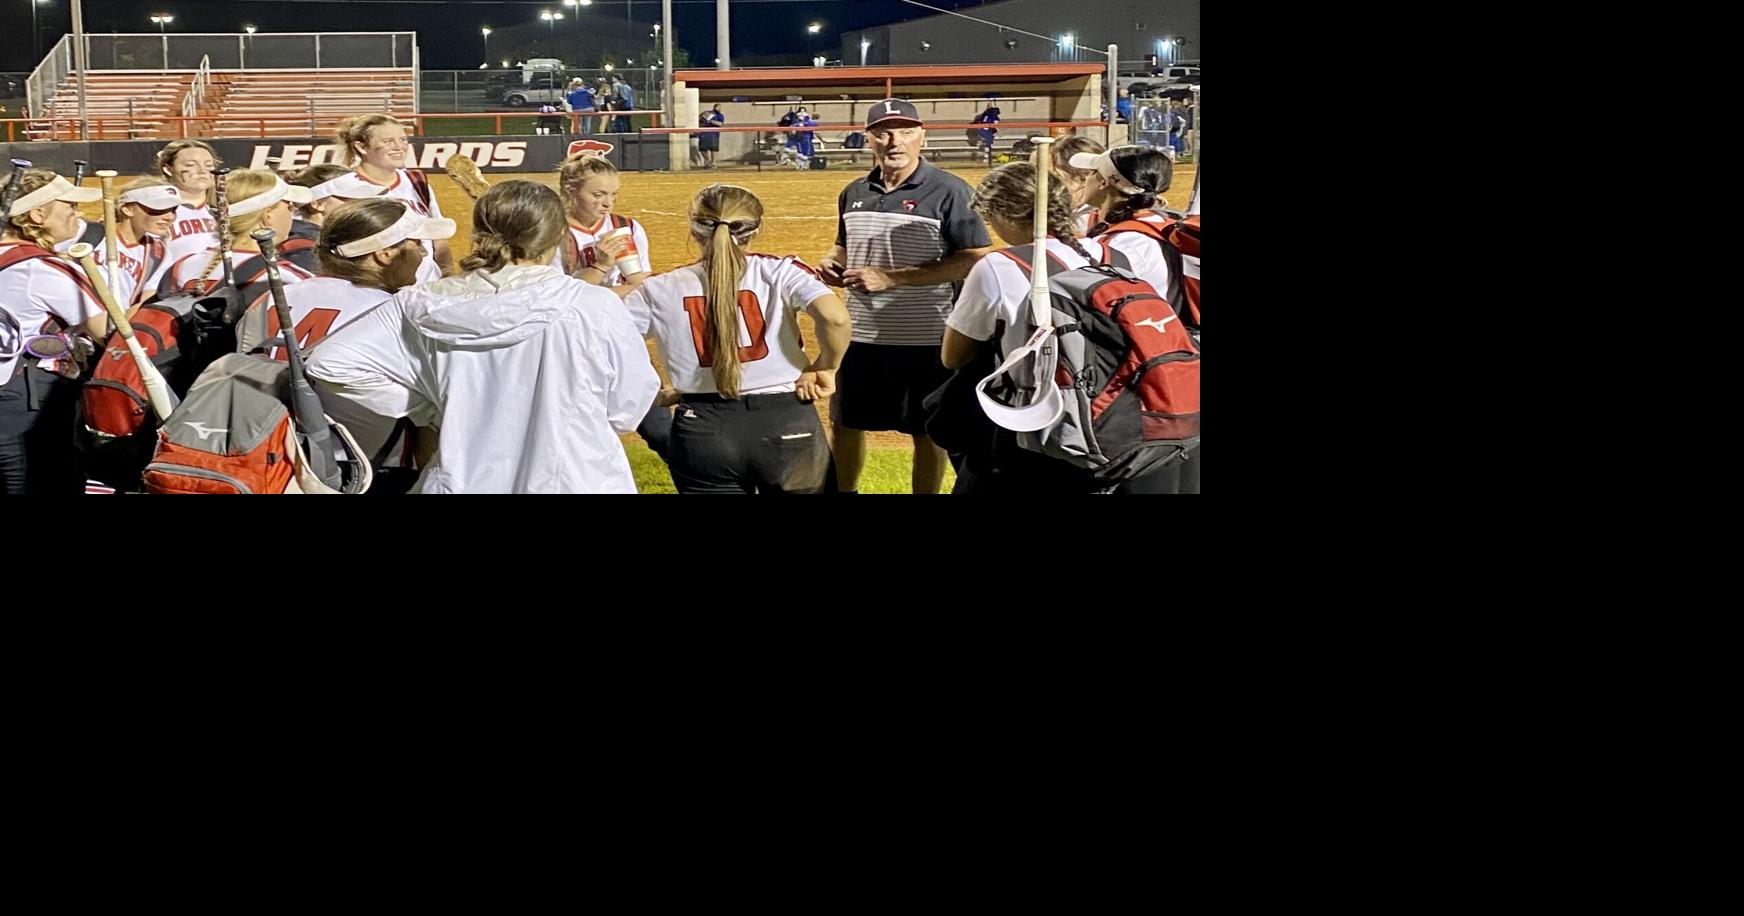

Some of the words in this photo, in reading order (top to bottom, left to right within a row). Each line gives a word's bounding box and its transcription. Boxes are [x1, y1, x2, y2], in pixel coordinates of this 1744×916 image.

[884, 101, 901, 115] L
[249, 141, 527, 171] LEORDS
[169, 218, 214, 240] LORE
